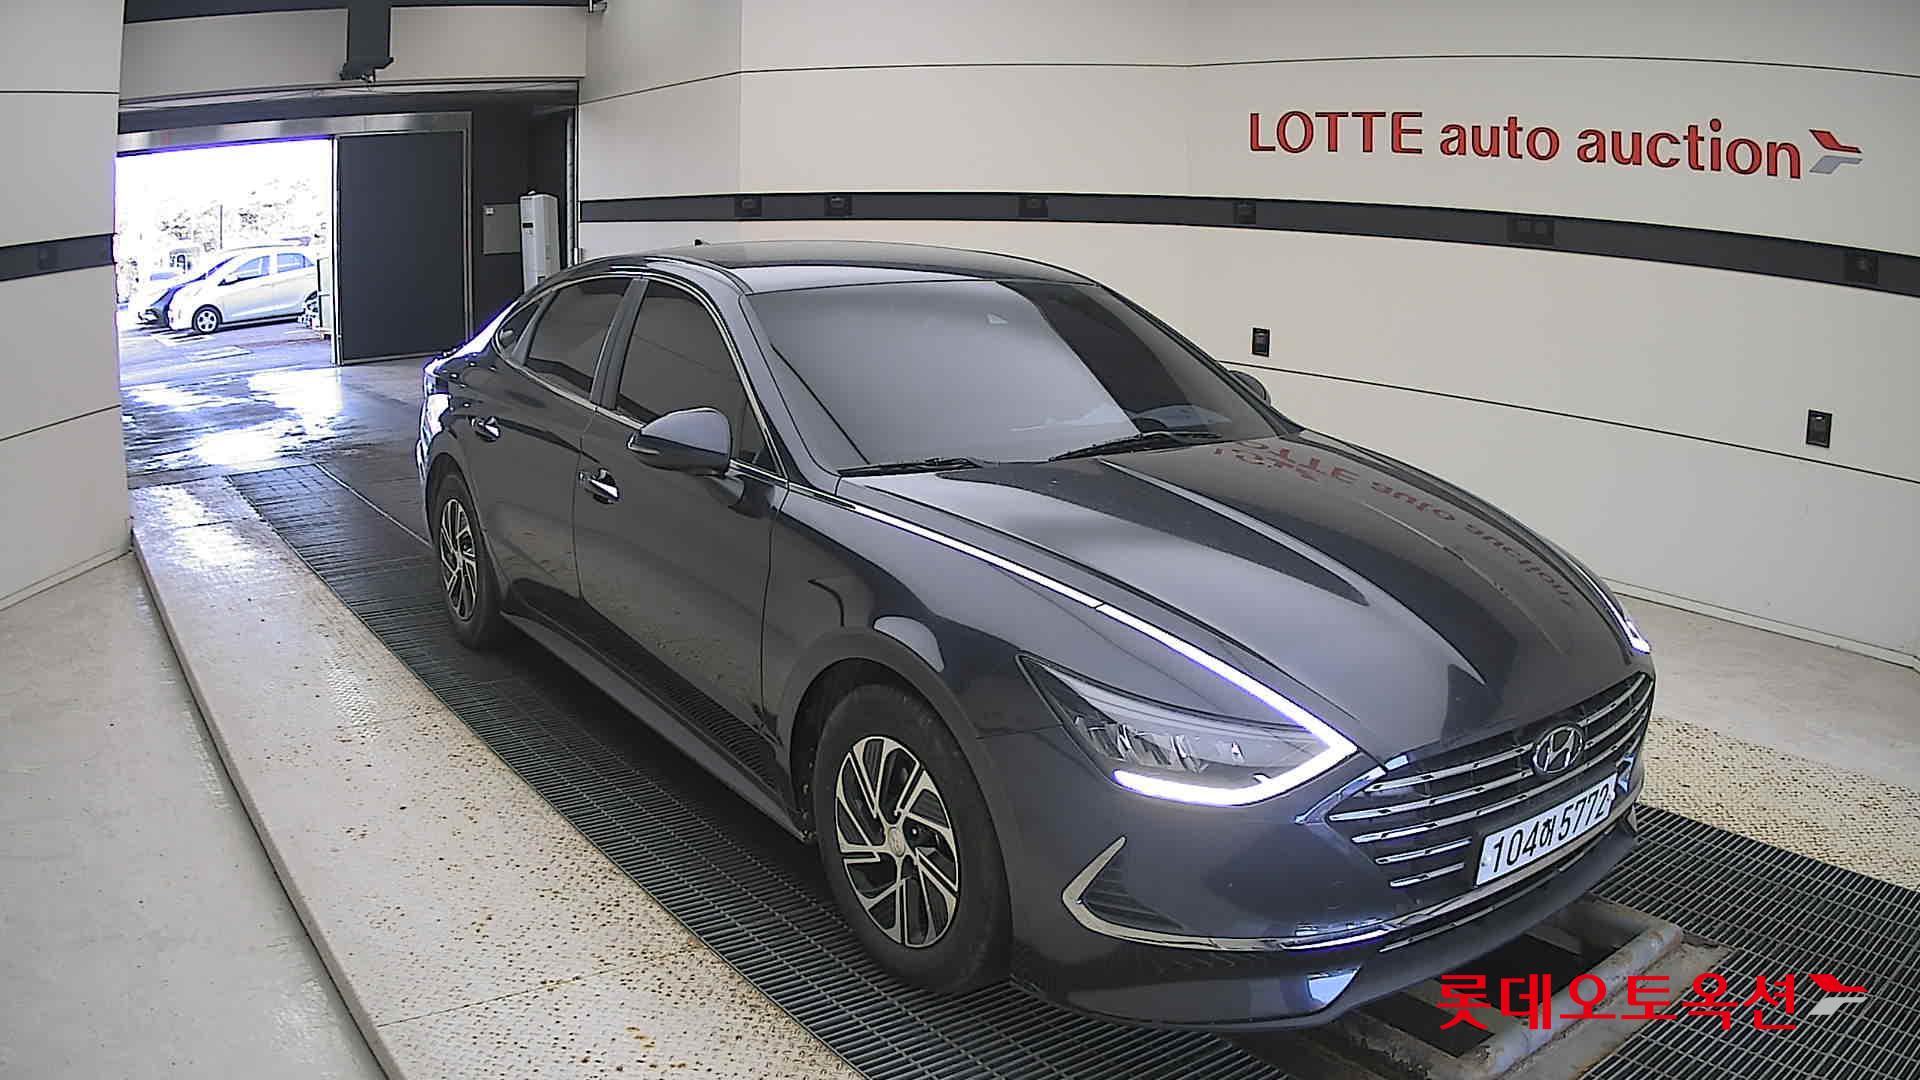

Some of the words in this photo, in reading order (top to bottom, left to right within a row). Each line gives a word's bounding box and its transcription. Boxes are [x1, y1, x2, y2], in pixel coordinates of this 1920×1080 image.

[1249, 111, 1423, 154] LOTTE
[1439, 115, 1560, 160] auto
[1576, 118, 1802, 179] auction
